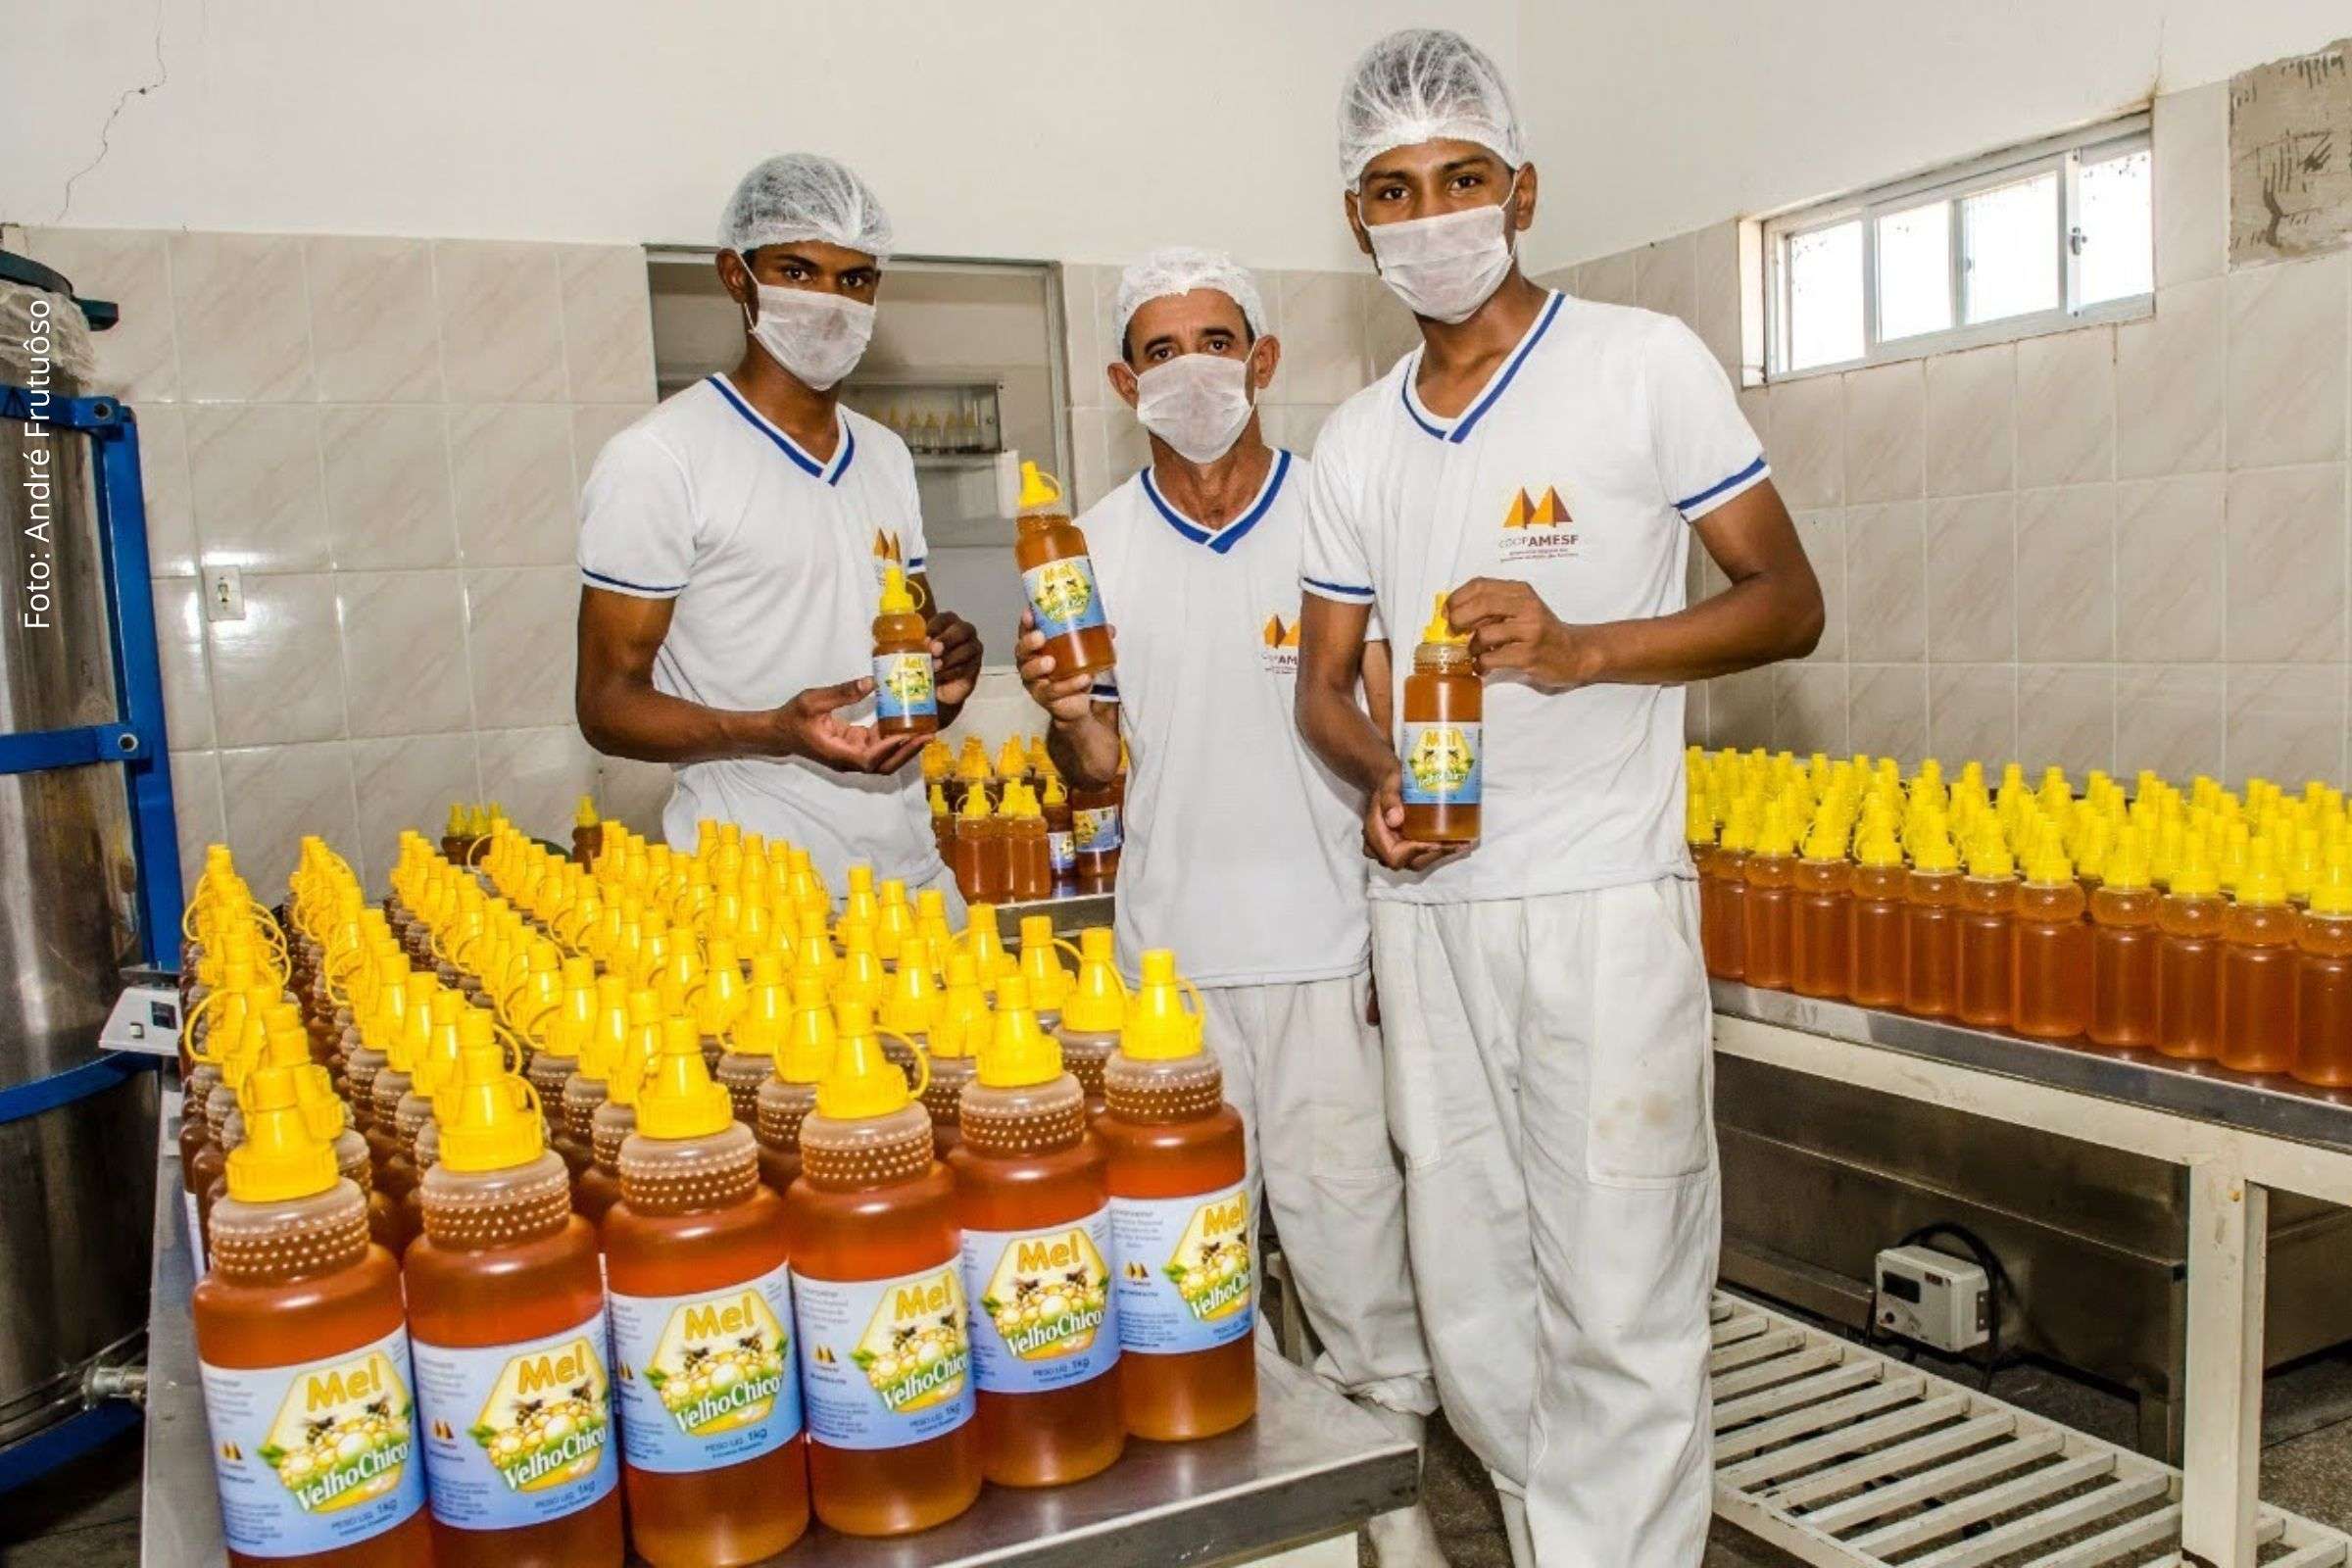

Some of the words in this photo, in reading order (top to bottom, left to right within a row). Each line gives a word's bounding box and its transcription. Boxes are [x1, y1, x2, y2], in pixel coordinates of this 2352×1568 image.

[1202, 1194, 1245, 1238] Mel
[1017, 1233, 1080, 1272] Mel
[686, 1294, 755, 1340] Mel
[895, 1275, 953, 1321] Mel
[1006, 1309, 1102, 1357] VelhoChico
[307, 1357, 381, 1412] Mel
[518, 1344, 586, 1395] Mel
[675, 1377, 780, 1433] VelhoChico
[296, 1443, 409, 1511] VelhoChico
[504, 1426, 607, 1490] VelhoChico
